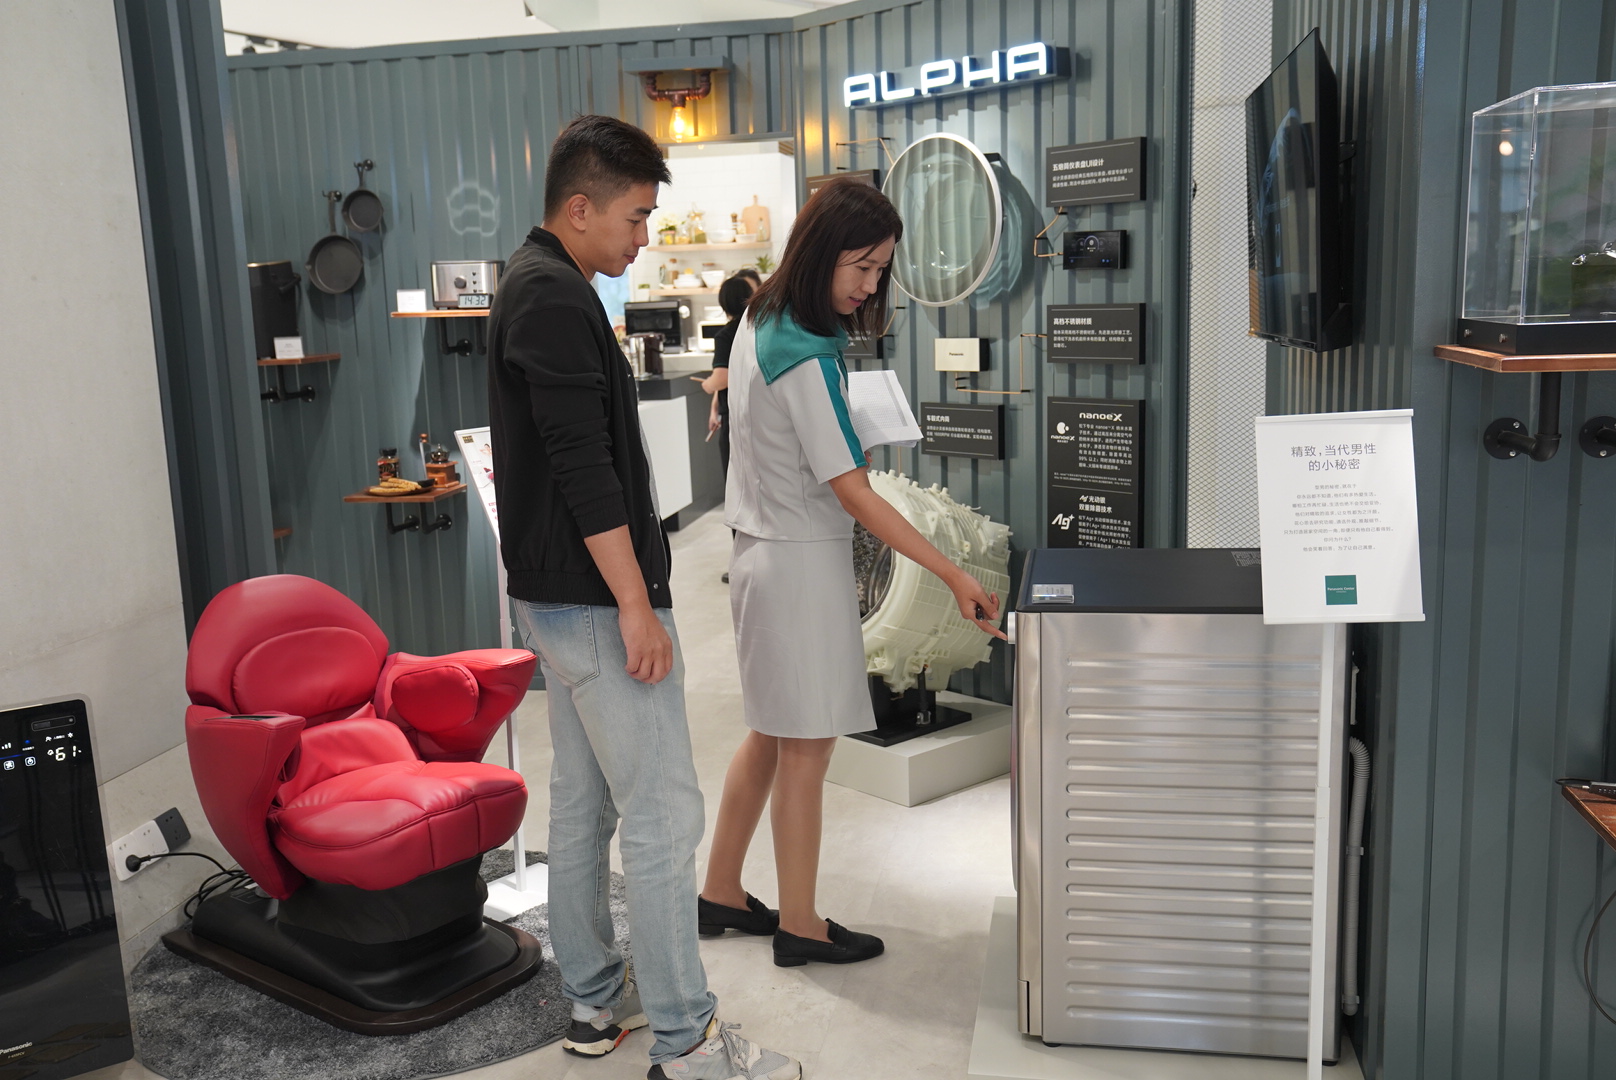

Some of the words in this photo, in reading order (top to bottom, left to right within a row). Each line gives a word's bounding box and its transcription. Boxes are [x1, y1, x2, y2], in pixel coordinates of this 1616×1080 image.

[843, 41, 1047, 108] ALPHA
[1291, 443, 1376, 457] 精致,当代男性
[1308, 458, 1360, 471] 的小秘密
